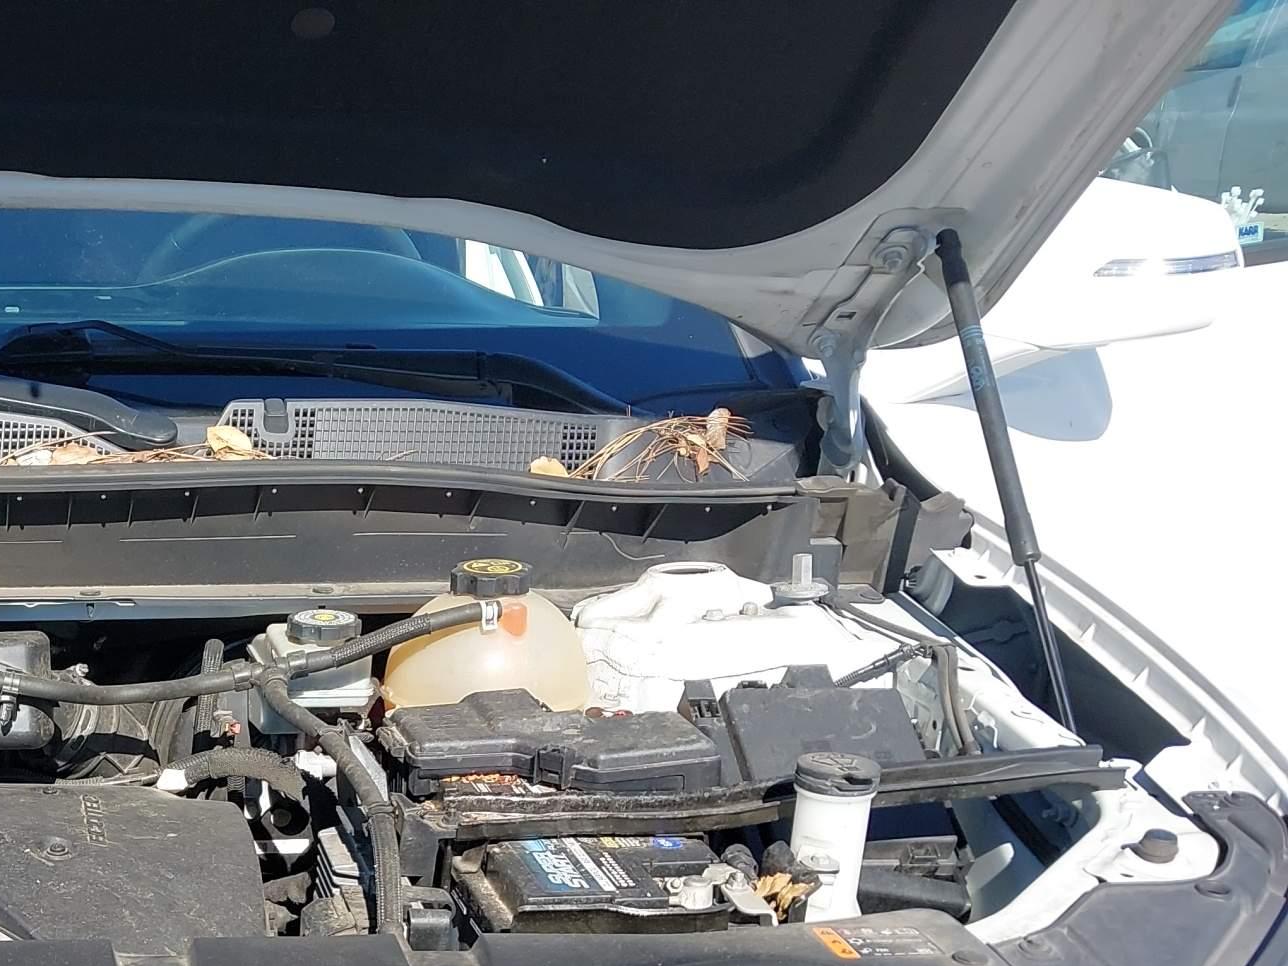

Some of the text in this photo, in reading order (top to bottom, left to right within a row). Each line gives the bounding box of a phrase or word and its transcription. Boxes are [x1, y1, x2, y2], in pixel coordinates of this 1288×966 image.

[80, 794, 108, 846] ECOTEC
[532, 850, 564, 885] SUPER
[552, 852, 590, 889] START
